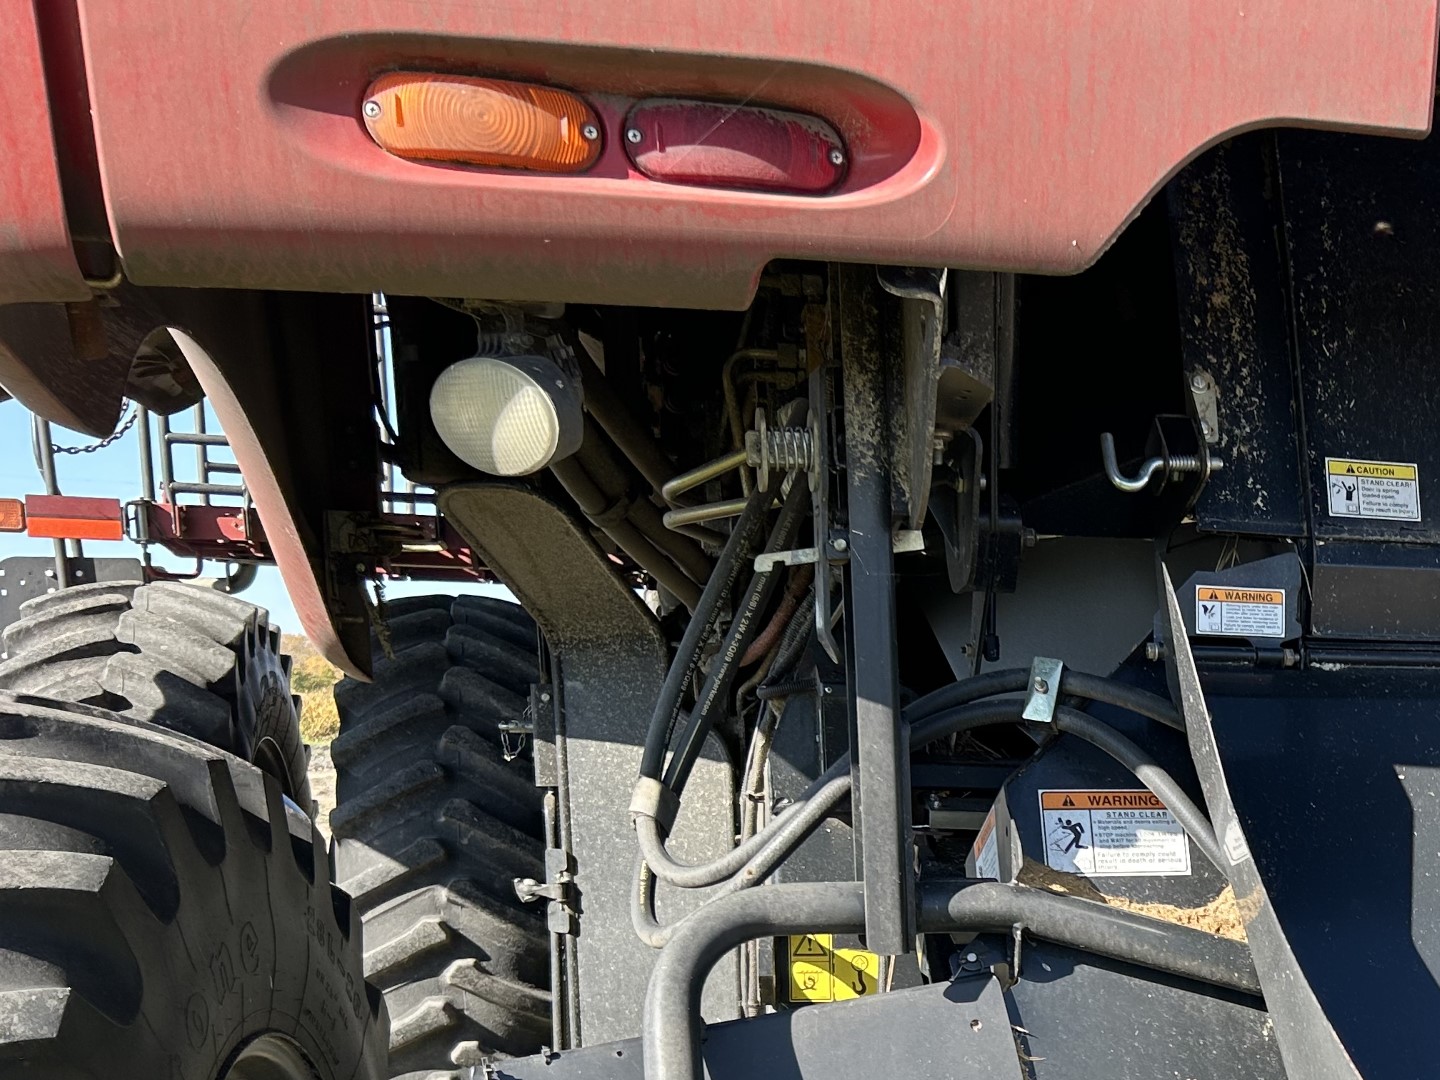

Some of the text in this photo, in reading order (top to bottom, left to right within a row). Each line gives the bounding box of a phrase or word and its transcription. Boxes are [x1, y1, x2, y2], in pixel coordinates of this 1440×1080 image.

[1356, 466, 1395, 476] CAUTION
[1361, 479, 1412, 489] STAND CLEAR!
[1224, 591, 1274, 603] WARNING
[1087, 795, 1159, 806] WARNING
[1138, 811, 1168, 819] CLEAR
